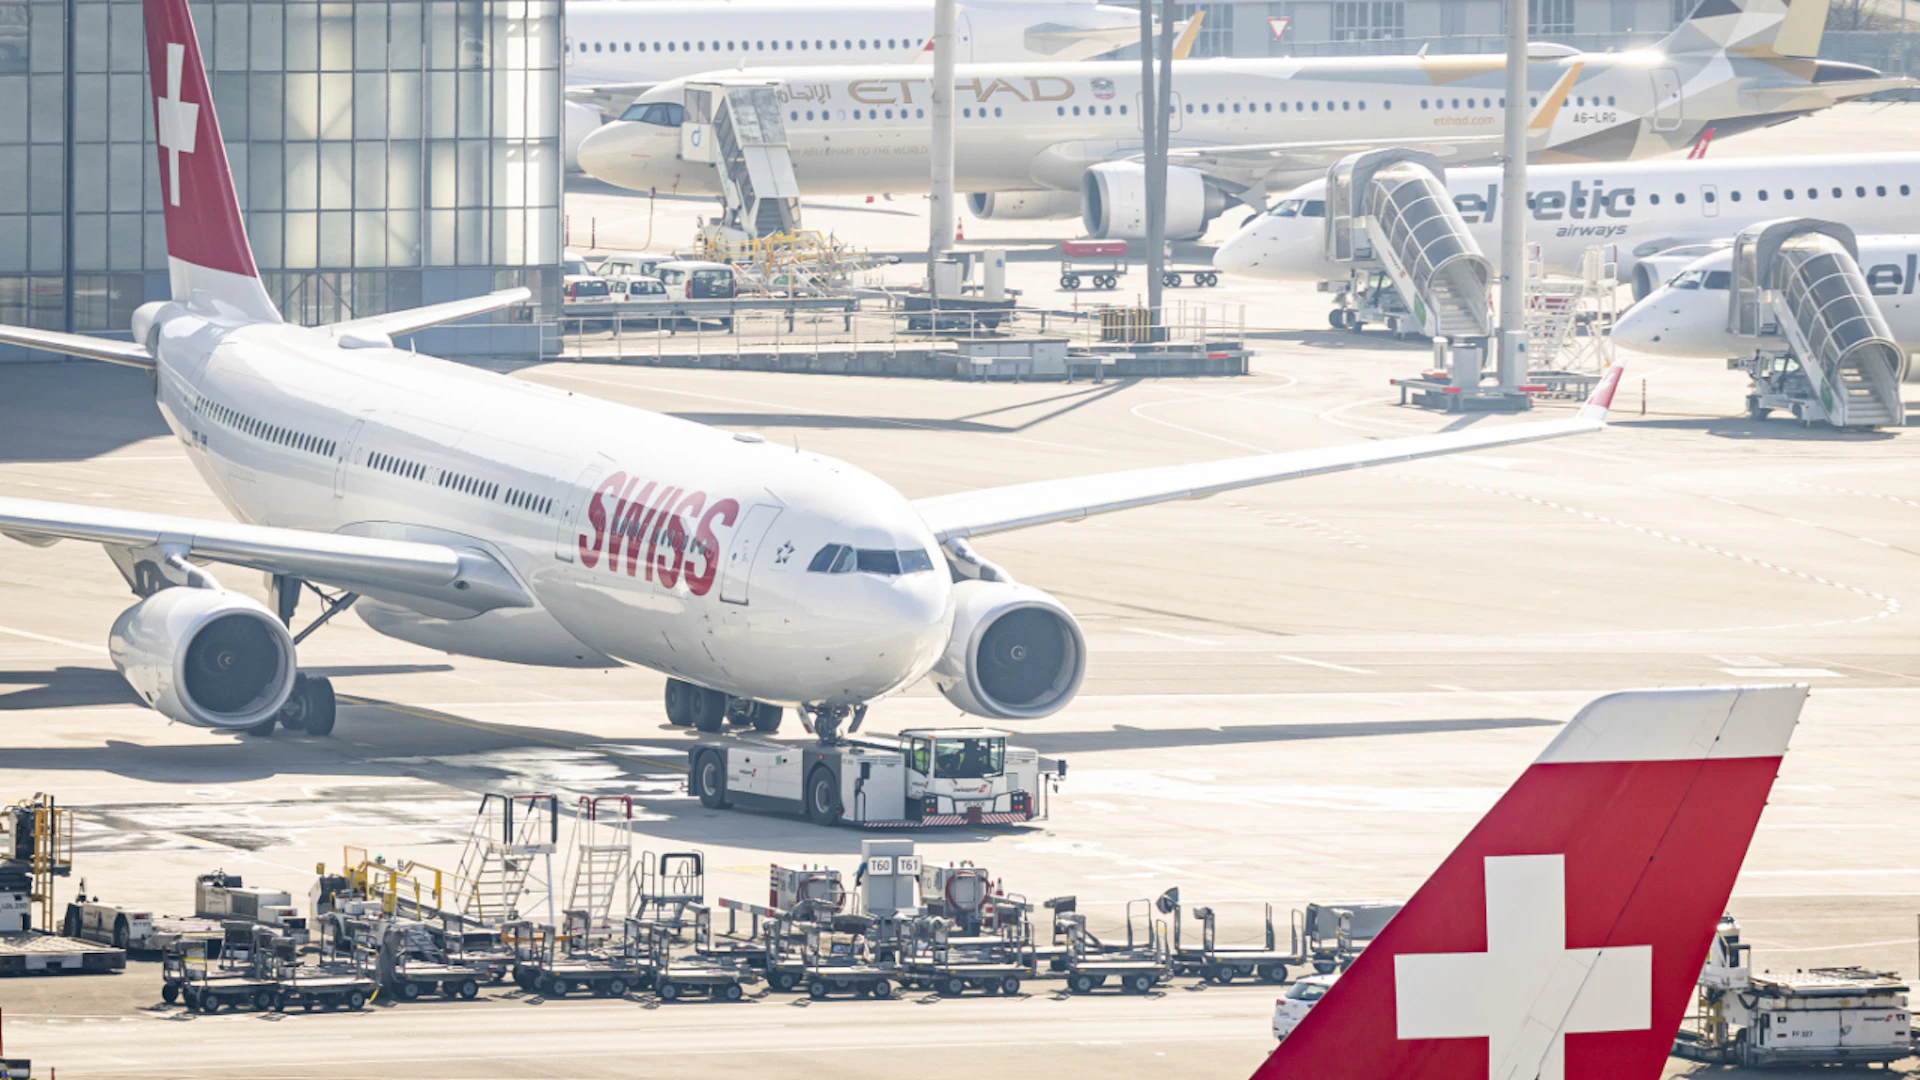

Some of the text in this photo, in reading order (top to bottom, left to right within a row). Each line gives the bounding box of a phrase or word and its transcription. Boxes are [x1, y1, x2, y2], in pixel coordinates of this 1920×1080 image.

[847, 77, 1075, 104] ETHAD
[1433, 115, 1495, 126] etihad.com
[1573, 112, 1617, 123] A6-LRG
[893, 144, 928, 156] WORLD
[1556, 224, 1628, 238] airways
[578, 470, 740, 597] SWISS
[871, 860, 890, 871] T60
[900, 860, 918, 871] T61
